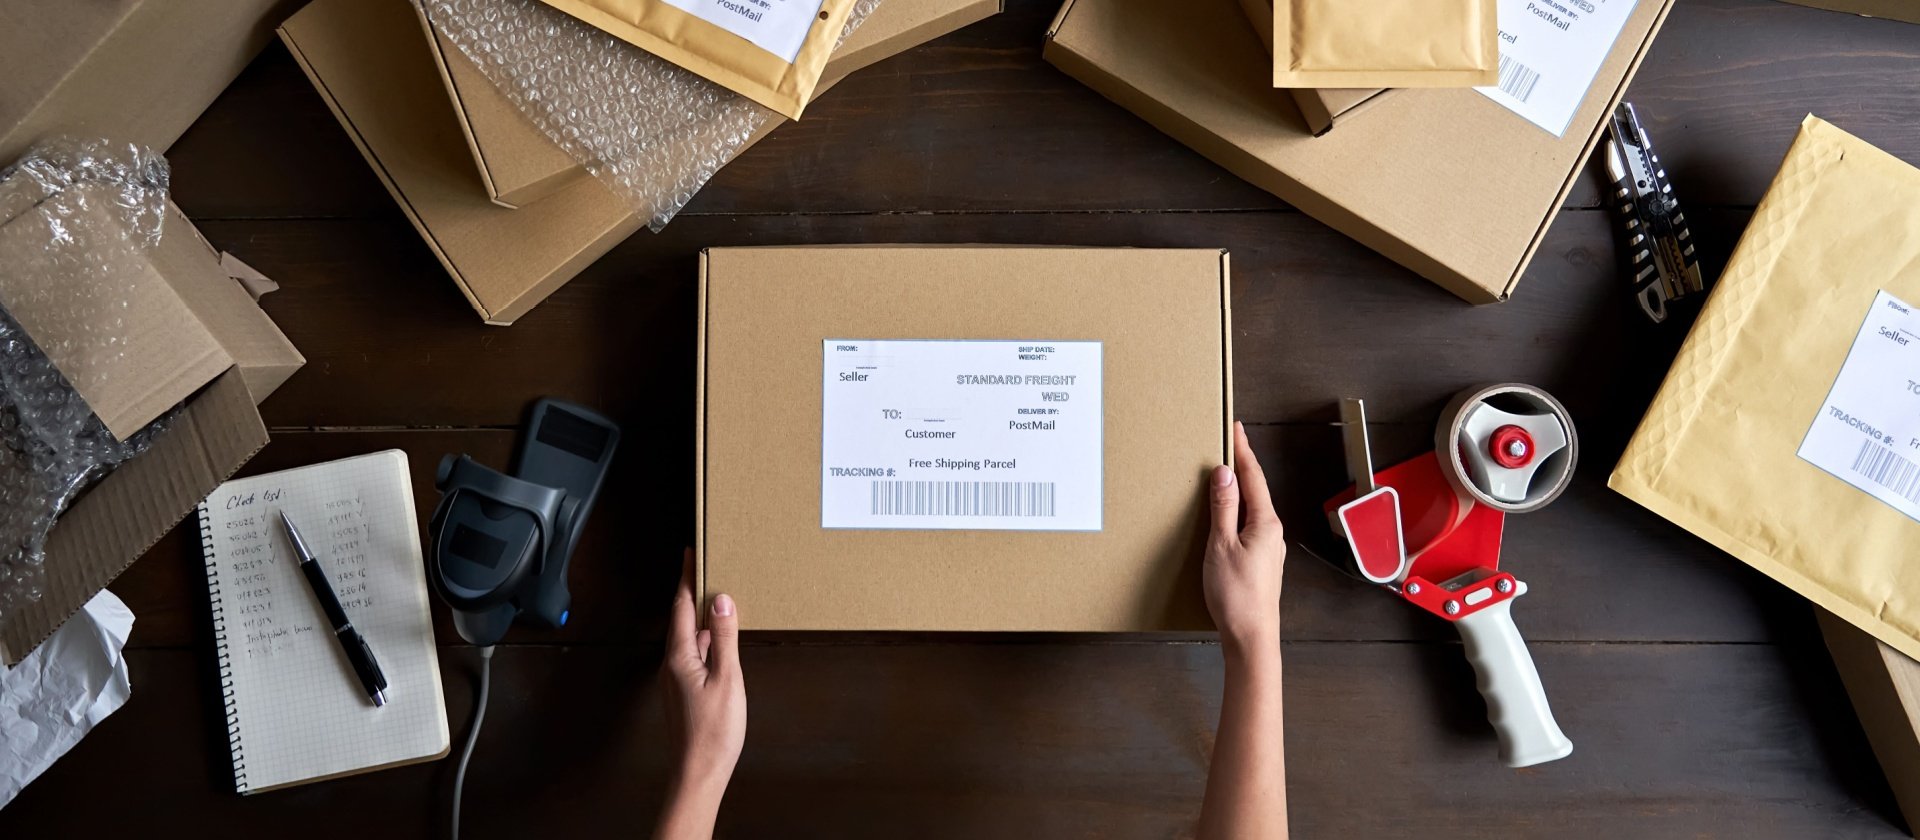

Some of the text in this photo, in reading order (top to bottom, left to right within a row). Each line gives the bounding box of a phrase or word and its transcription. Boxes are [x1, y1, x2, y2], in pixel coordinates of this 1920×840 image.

[717, 0, 763, 22] PostMail
[1527, 2, 1570, 31] PostMail
[1497, 29, 1518, 44] rcel
[1878, 326, 1910, 346] Seller
[839, 371, 869, 382] Seller
[956, 374, 1077, 386] STANDARD FREIGHT
[1041, 391, 1070, 402] WED
[882, 409, 902, 420] TO:
[1009, 420, 1056, 430] PostMail
[1829, 405, 1883, 440] TRACKING
[905, 429, 956, 439] Customer
[909, 458, 1016, 471] Free Shipping Parcel
[830, 467, 896, 477] TRACKING #:
